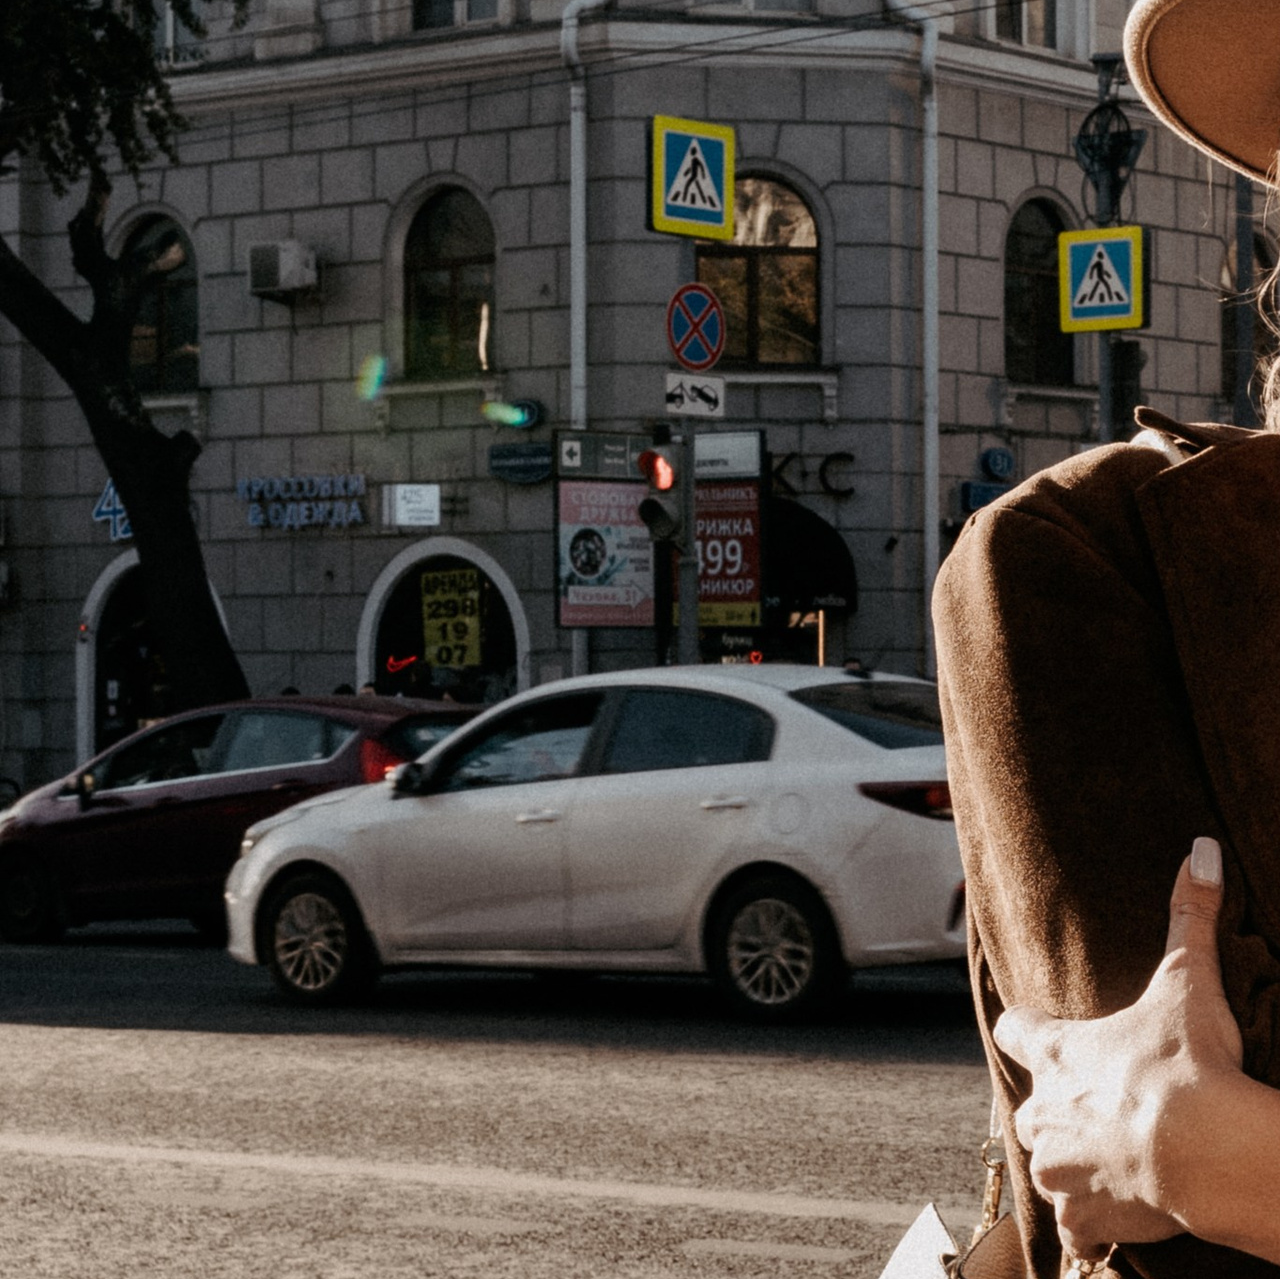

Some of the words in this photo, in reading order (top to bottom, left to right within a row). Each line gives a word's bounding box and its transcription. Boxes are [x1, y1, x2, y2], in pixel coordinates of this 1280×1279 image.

[237, 475, 365, 500] КРОССОВКИ
[268, 499, 364, 529] ОДЕЖДА
[696, 519, 755, 537] РИЖКА
[698, 579, 755, 596] НИКЮР
[427, 598, 476, 619] 298
[437, 621, 468, 640] 19
[436, 645, 467, 663] 07
